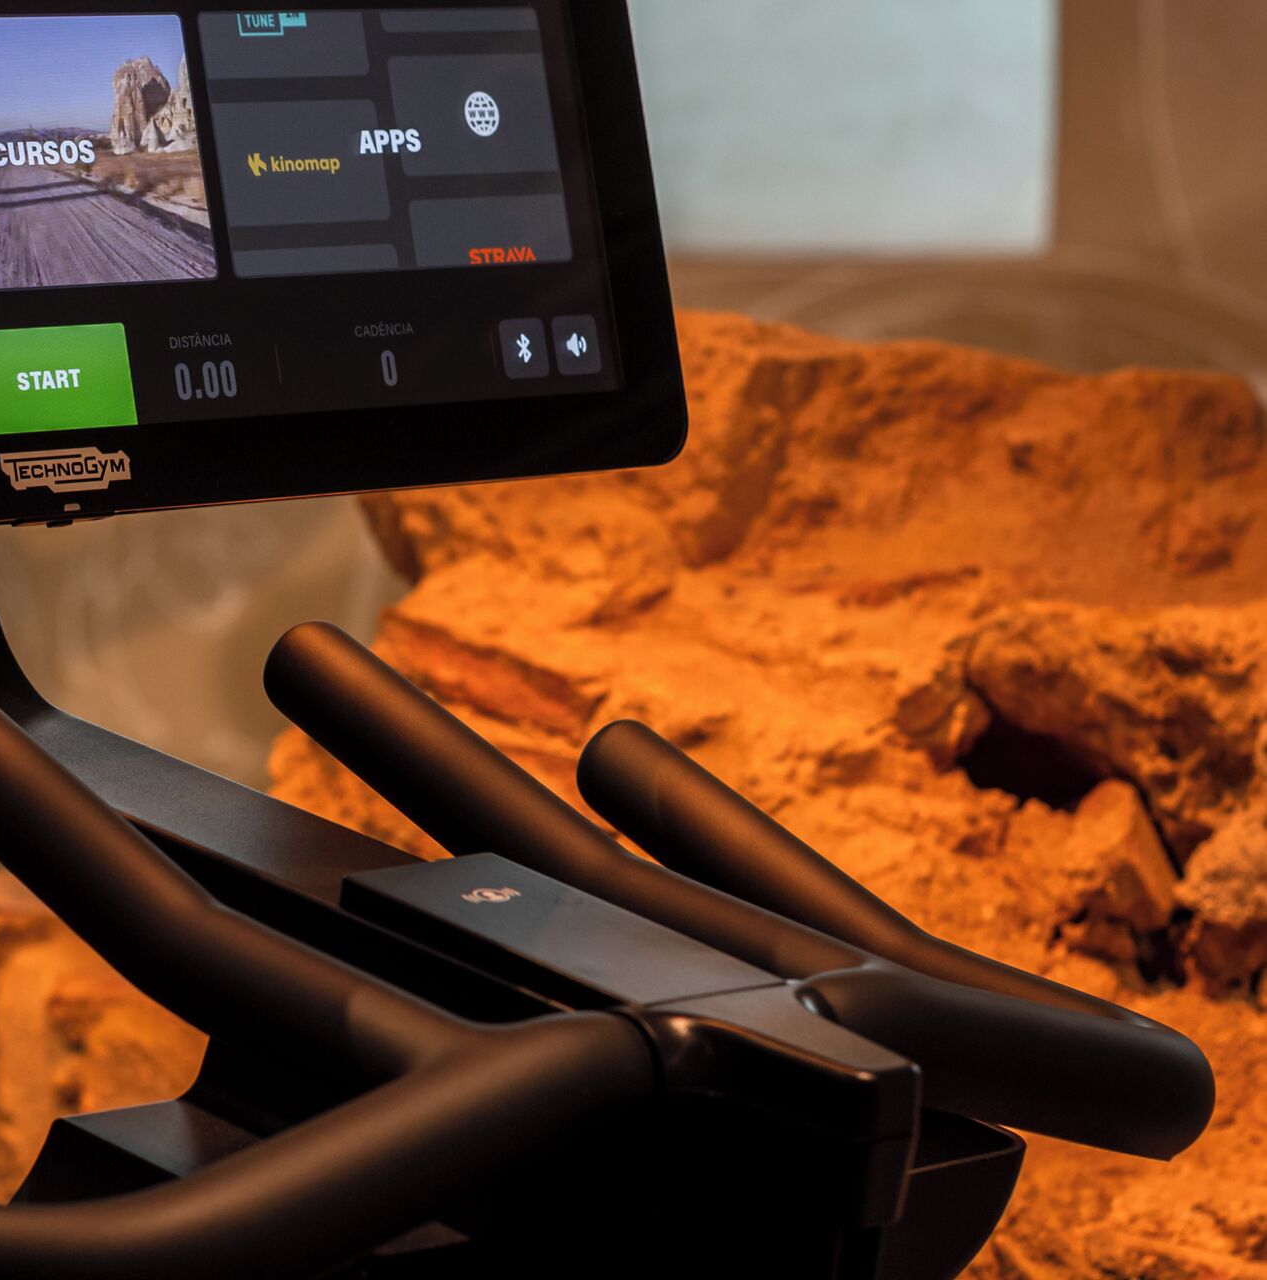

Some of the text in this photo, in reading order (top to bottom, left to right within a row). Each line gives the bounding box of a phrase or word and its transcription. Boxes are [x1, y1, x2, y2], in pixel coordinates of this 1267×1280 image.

[244, 13, 275, 28] TUNE
[359, 128, 422, 154] APPS
[270, 155, 341, 175] kinomap
[468, 246, 536, 265] STRAVA
[354, 321, 414, 338] CADÊNCIA
[169, 332, 233, 350] DISTÂNCIA
[380, 350, 398, 387] 0
[17, 368, 81, 391] START
[174, 360, 238, 401] 0.00
